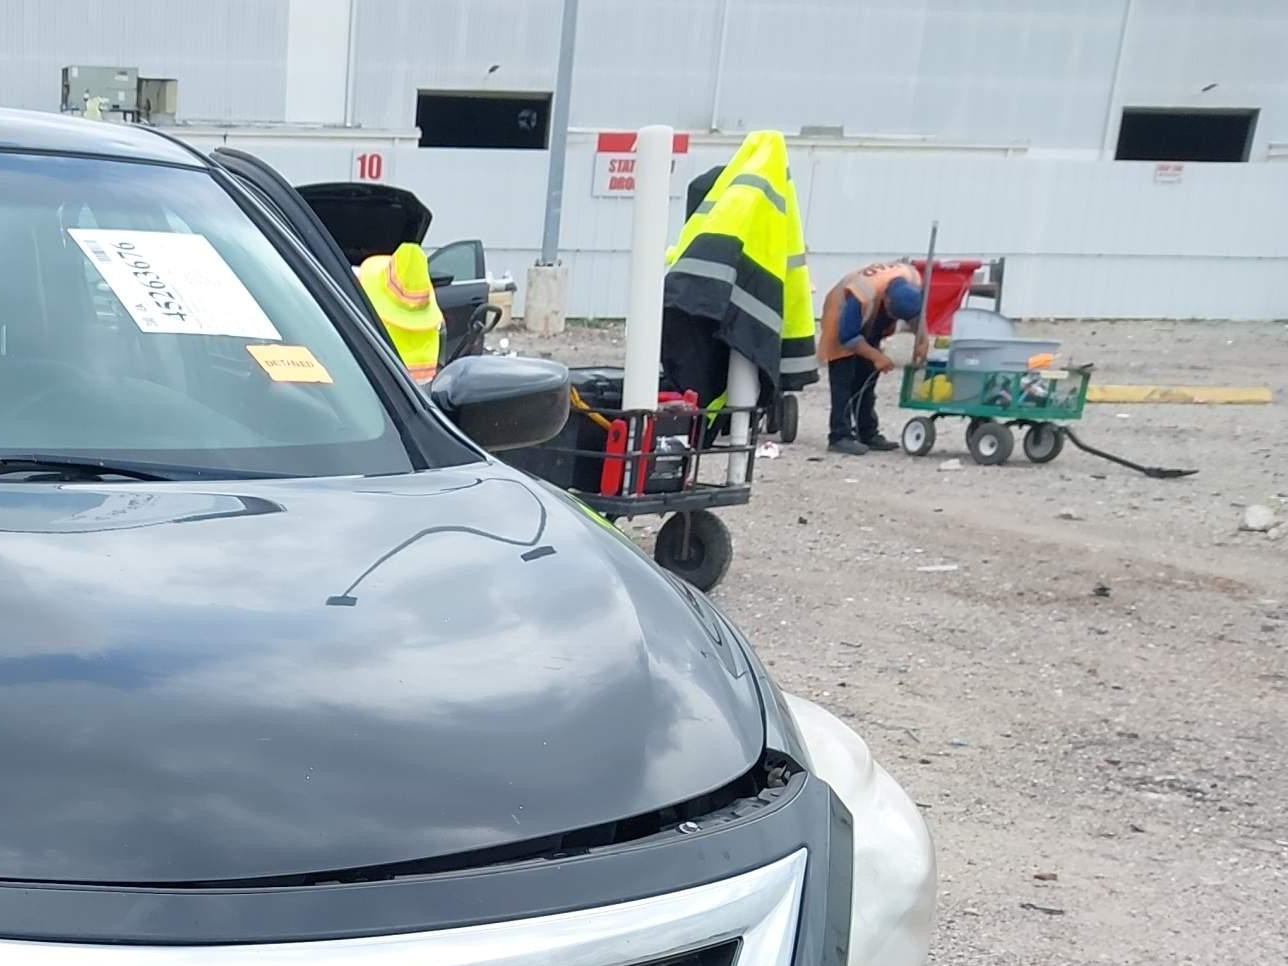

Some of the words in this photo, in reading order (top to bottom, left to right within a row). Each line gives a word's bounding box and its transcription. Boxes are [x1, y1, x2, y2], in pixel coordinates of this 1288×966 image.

[357, 153, 382, 180] 10
[608, 158, 637, 173] STAT
[608, 175, 636, 191] DRO
[111, 241, 187, 322] 45263676
